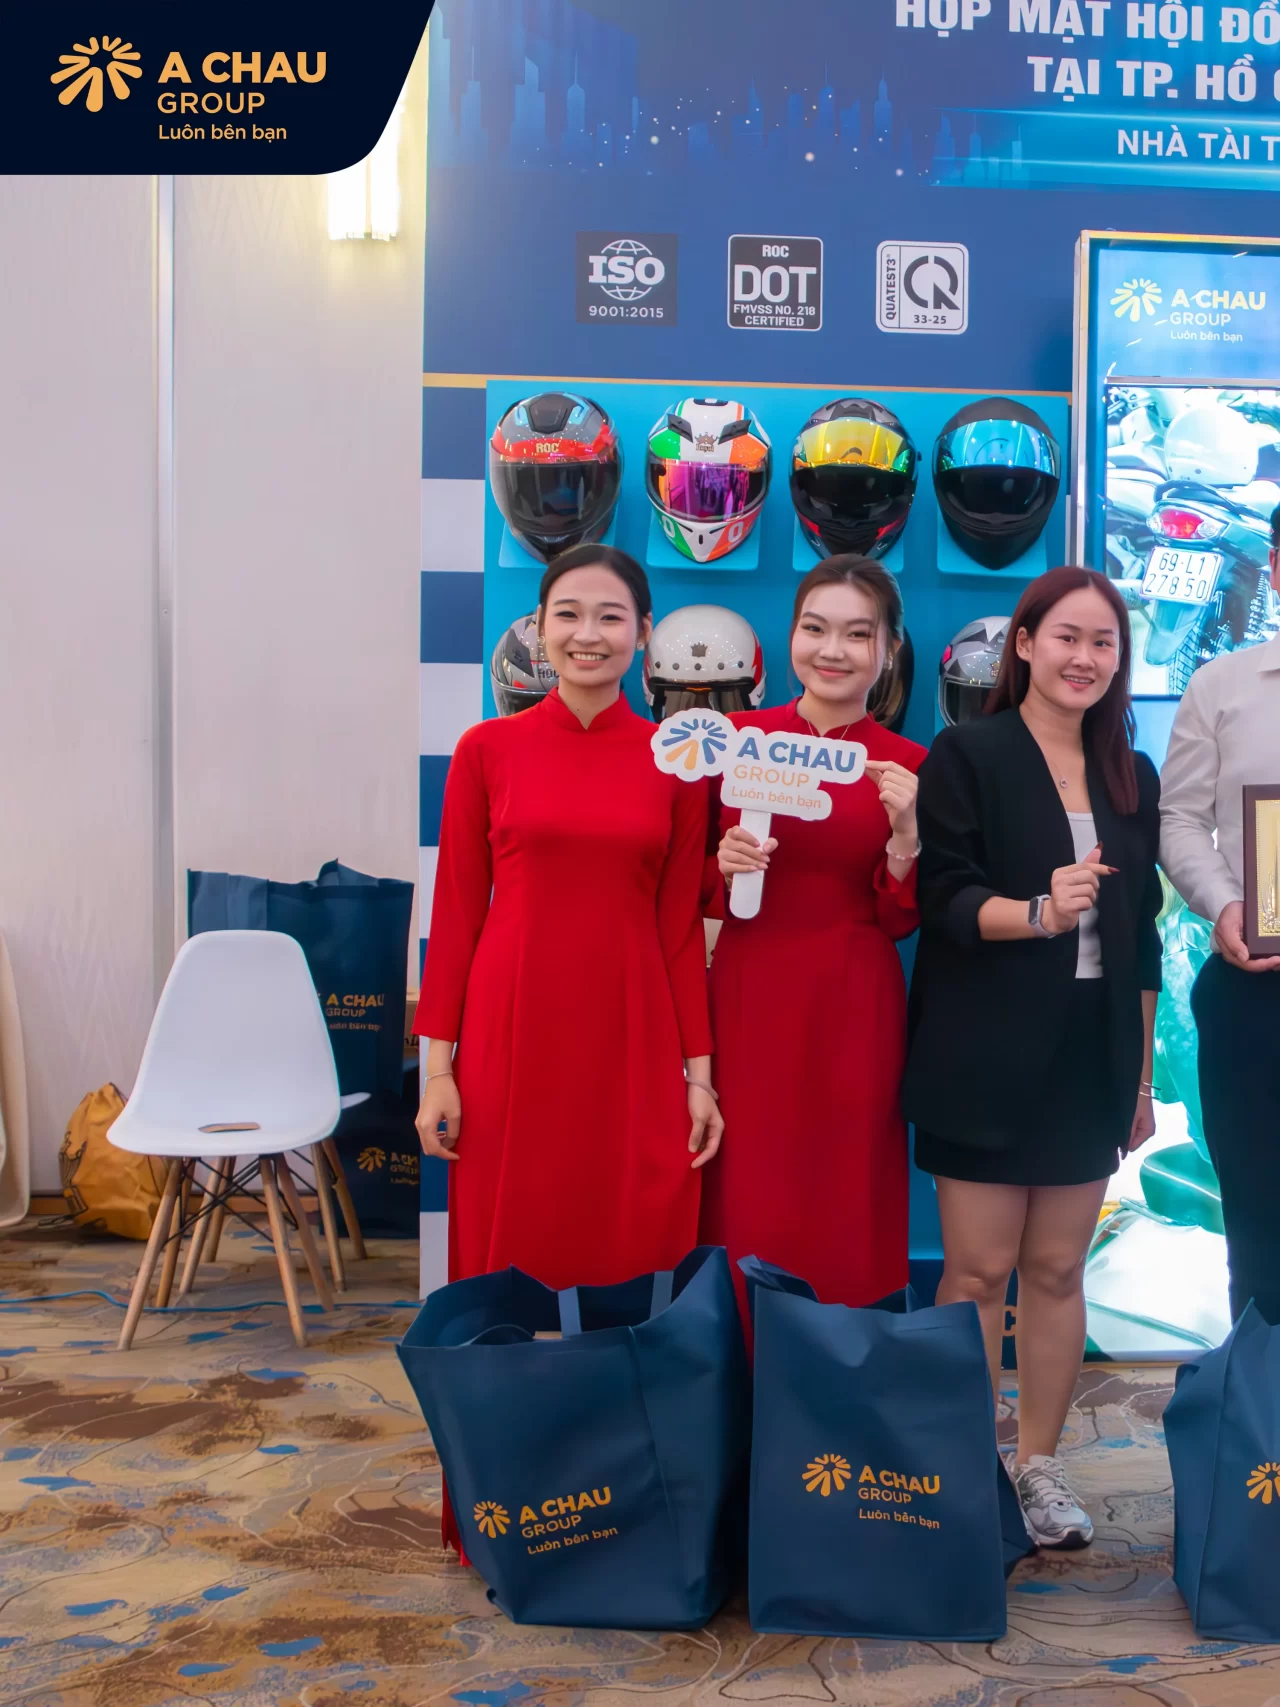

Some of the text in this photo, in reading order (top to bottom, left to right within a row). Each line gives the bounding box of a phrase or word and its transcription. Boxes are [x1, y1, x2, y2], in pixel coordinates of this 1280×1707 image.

[1027, 56, 1100, 102] TẠI
[1116, 60, 1179, 98] TP.
[1195, 54, 1257, 103] HỒ
[1117, 124, 1188, 157] NHÀ
[1198, 127, 1250, 160] TÀI
[762, 244, 789, 258] ROC
[588, 255, 665, 286] ISO
[734, 264, 817, 303] DOT
[733, 303, 816, 316] FMVSS NO. 218
[1170, 288, 1266, 311] A CHAU
[588, 305, 664, 319] 9001:2015
[744, 315, 805, 327] CERTIFIED
[913, 314, 947, 325] 33-25
[1170, 311, 1231, 326] GROUP
[1170, 330, 1243, 343] Luôn bên bạn
[536, 442, 560, 453] ROC
[737, 737, 856, 773] A CHAU
[733, 764, 810, 788] GROUP
[731, 786, 821, 810] Luôn bên bạn
[326, 993, 339, 1006] A
[325, 1007, 366, 1018] GROUP
[858, 1465, 941, 1495] A CHAU
[519, 1486, 612, 1525] A CHAU
[858, 1487, 912, 1504] GROUP
[521, 1514, 582, 1538] GROUP
[859, 1508, 940, 1530] Luôn bên bạn
[527, 1527, 619, 1555] Luôn bên bạn
